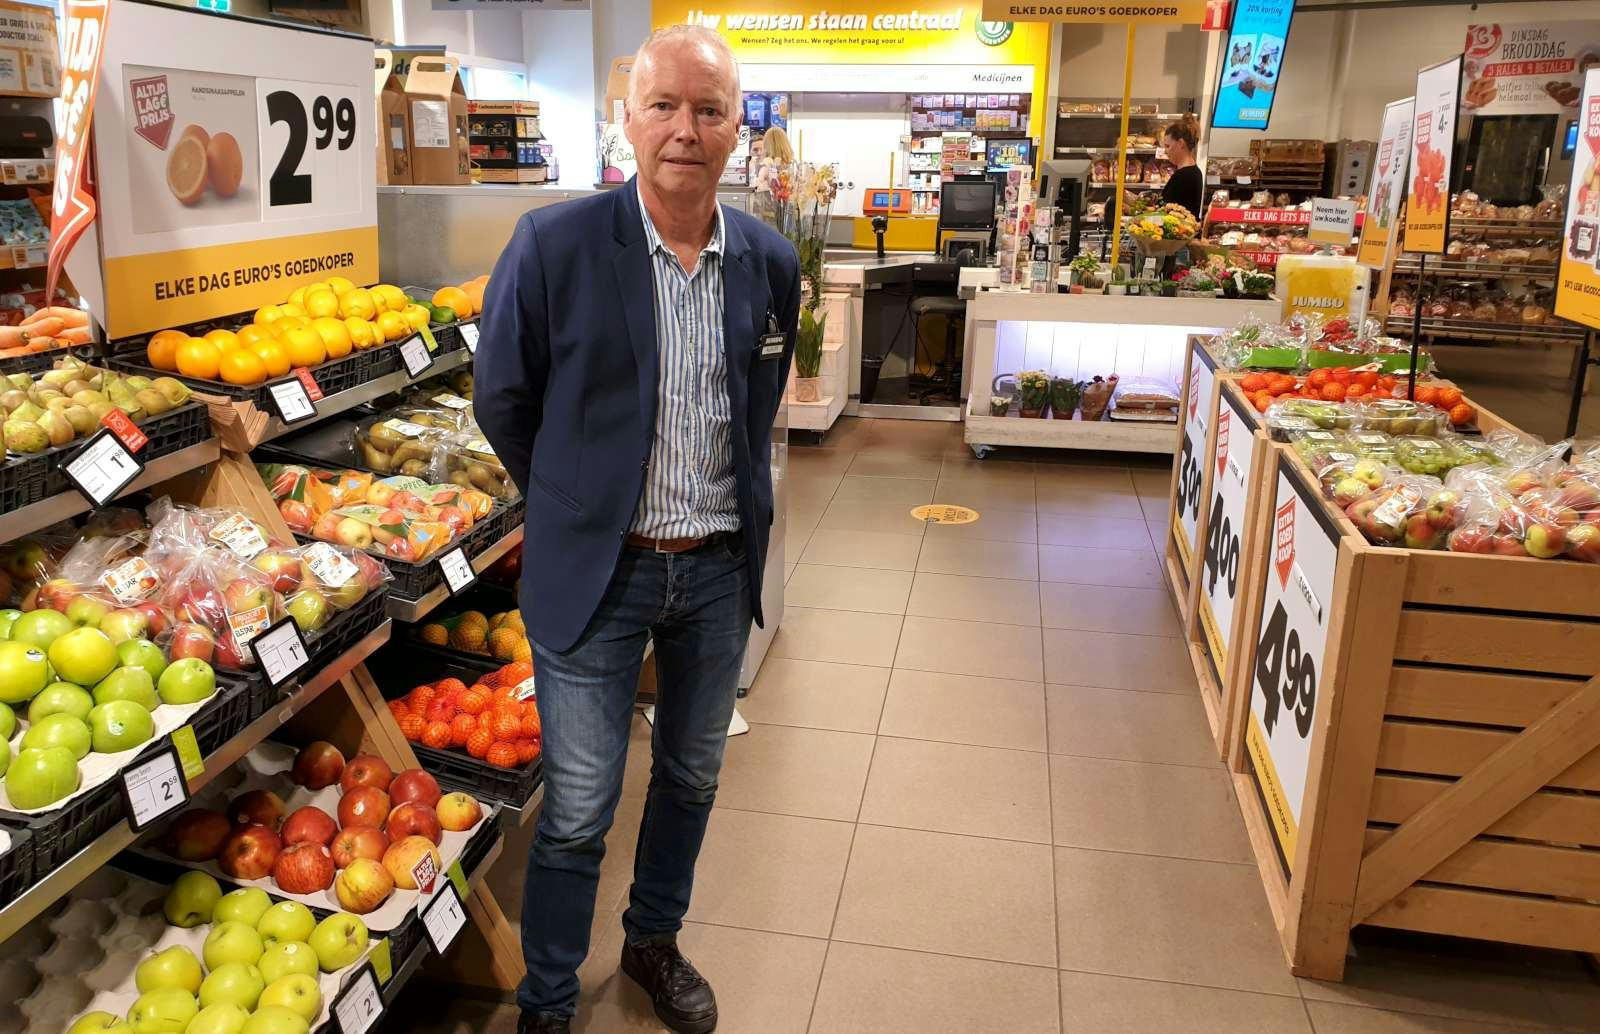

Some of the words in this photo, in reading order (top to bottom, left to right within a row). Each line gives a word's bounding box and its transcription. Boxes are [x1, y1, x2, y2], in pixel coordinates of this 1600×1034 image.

[1009, 6, 1036, 15] ELKE
[1039, 6, 1064, 15] DAG
[1066, 6, 1106, 16] EURO'S
[1109, 6, 1178, 16] GOEDKOPER
[687, 10, 720, 29] Uw
[726, 14, 804, 30] wensen
[808, 11, 867, 30] staan
[873, 8, 963, 30] centraal
[1511, 28, 1549, 41] DINSDAG
[771, 37, 782, 45] Zeg
[823, 37, 847, 45] regelen
[861, 38, 879, 46] graag
[1502, 42, 1566, 60] BROODDAG
[973, 74, 1022, 84] Medicijnen
[136, 82, 166, 99] ALTIJD
[138, 95, 168, 114] LAGE
[140, 108, 170, 128] PRIJS
[1316, 206, 1334, 214] Neem
[1243, 211, 1261, 220] ELKE
[1263, 212, 1278, 221] DAG
[1299, 213, 1312, 222] BE
[1325, 215, 1350, 225] koeltas!
[1257, 254, 1271, 263] DAG
[155, 276, 195, 300] ELKE
[199, 268, 230, 292] DAG
[234, 259, 281, 286] EURO'S
[284, 252, 354, 279] GOEDKOPER
[1291, 296, 1344, 308] JUMBO
[1279, 509, 1293, 527] EXTRA
[1279, 525, 1292, 547] GOED
[234, 625, 255, 637] ELSTAR
